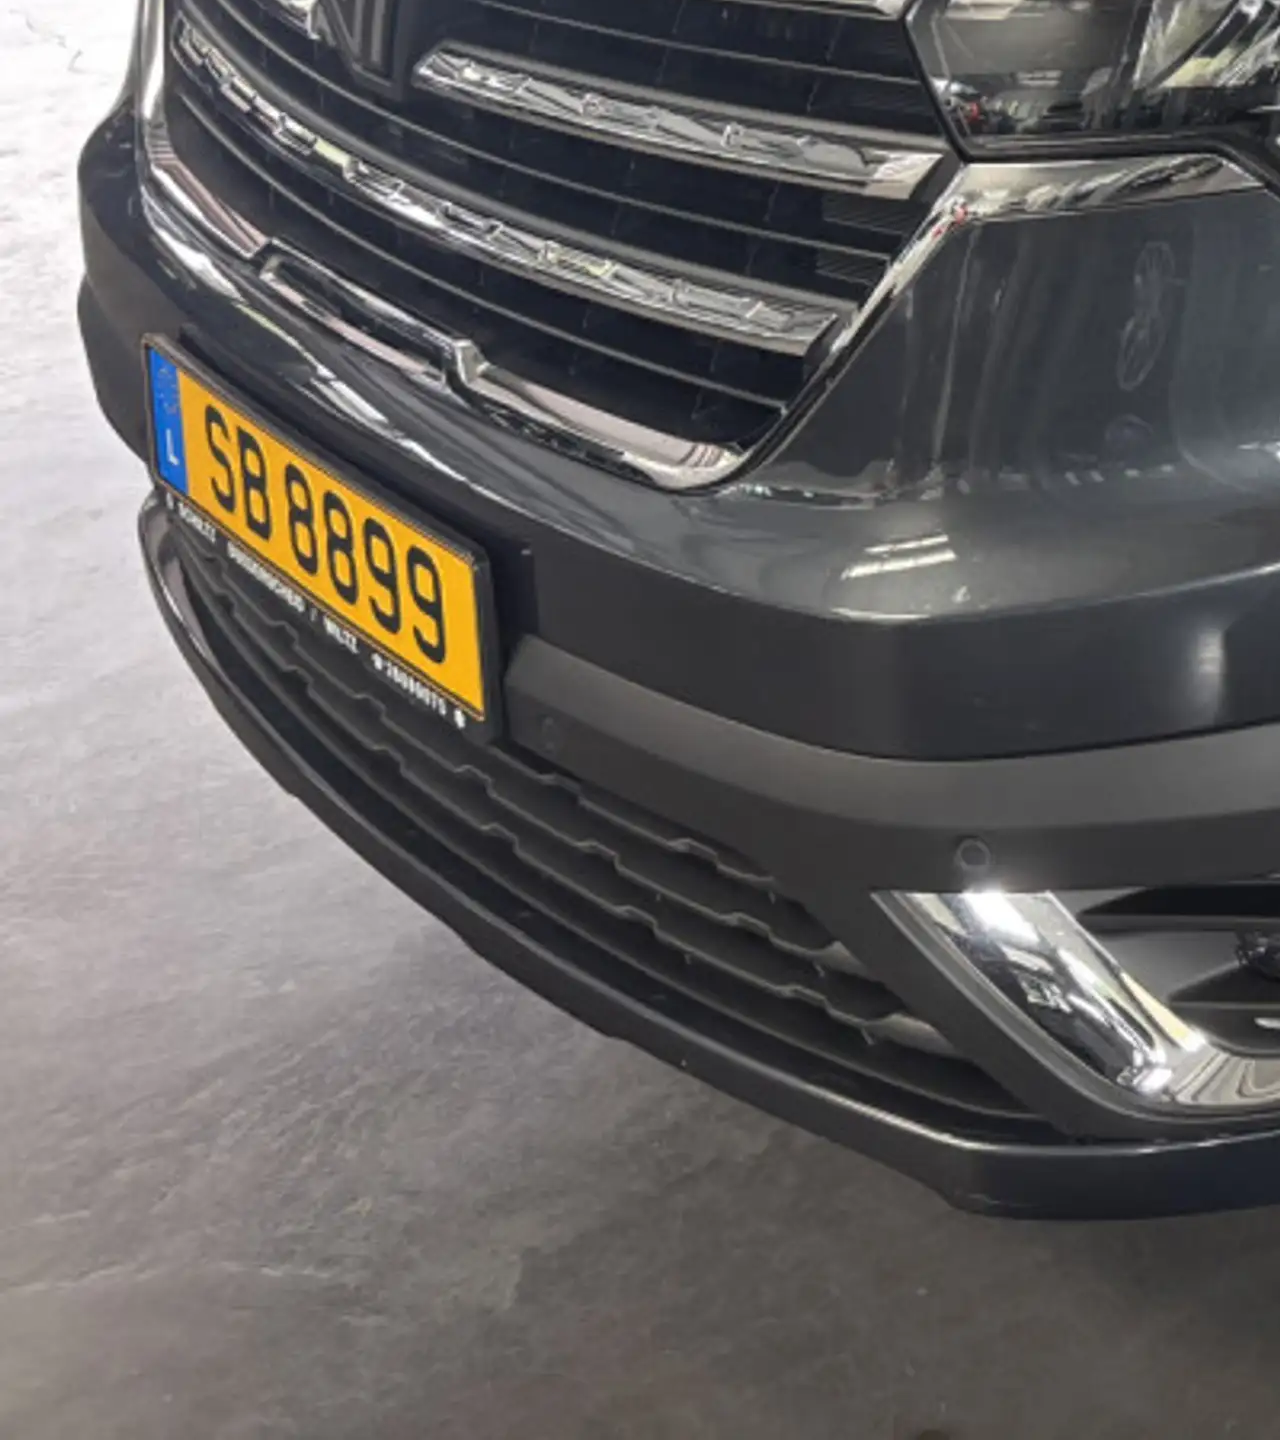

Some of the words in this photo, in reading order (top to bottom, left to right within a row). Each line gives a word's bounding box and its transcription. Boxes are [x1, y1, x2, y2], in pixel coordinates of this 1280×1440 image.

[166, 429, 179, 465] L
[205, 404, 272, 542] SB
[284, 463, 447, 664] 8899
